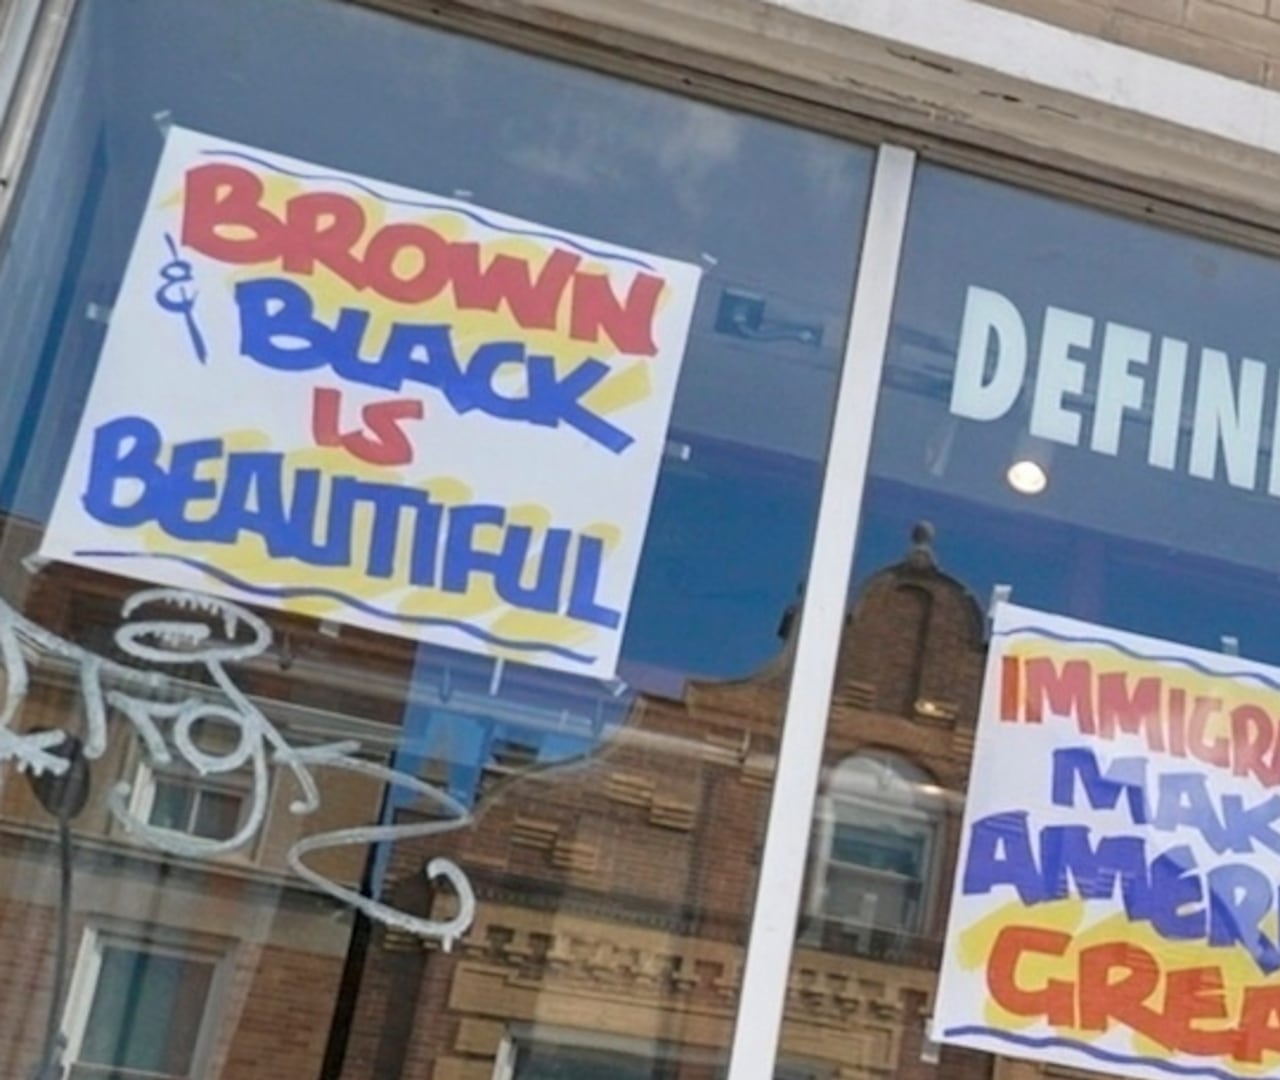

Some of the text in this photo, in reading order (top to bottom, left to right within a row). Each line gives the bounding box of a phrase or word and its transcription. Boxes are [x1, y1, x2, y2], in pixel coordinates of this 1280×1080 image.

[155, 232, 635, 456] & BLACK
[180, 163, 665, 357] BROWN
[81, 416, 622, 631] BEAUTIFUL
[311, 387, 425, 466] IS
